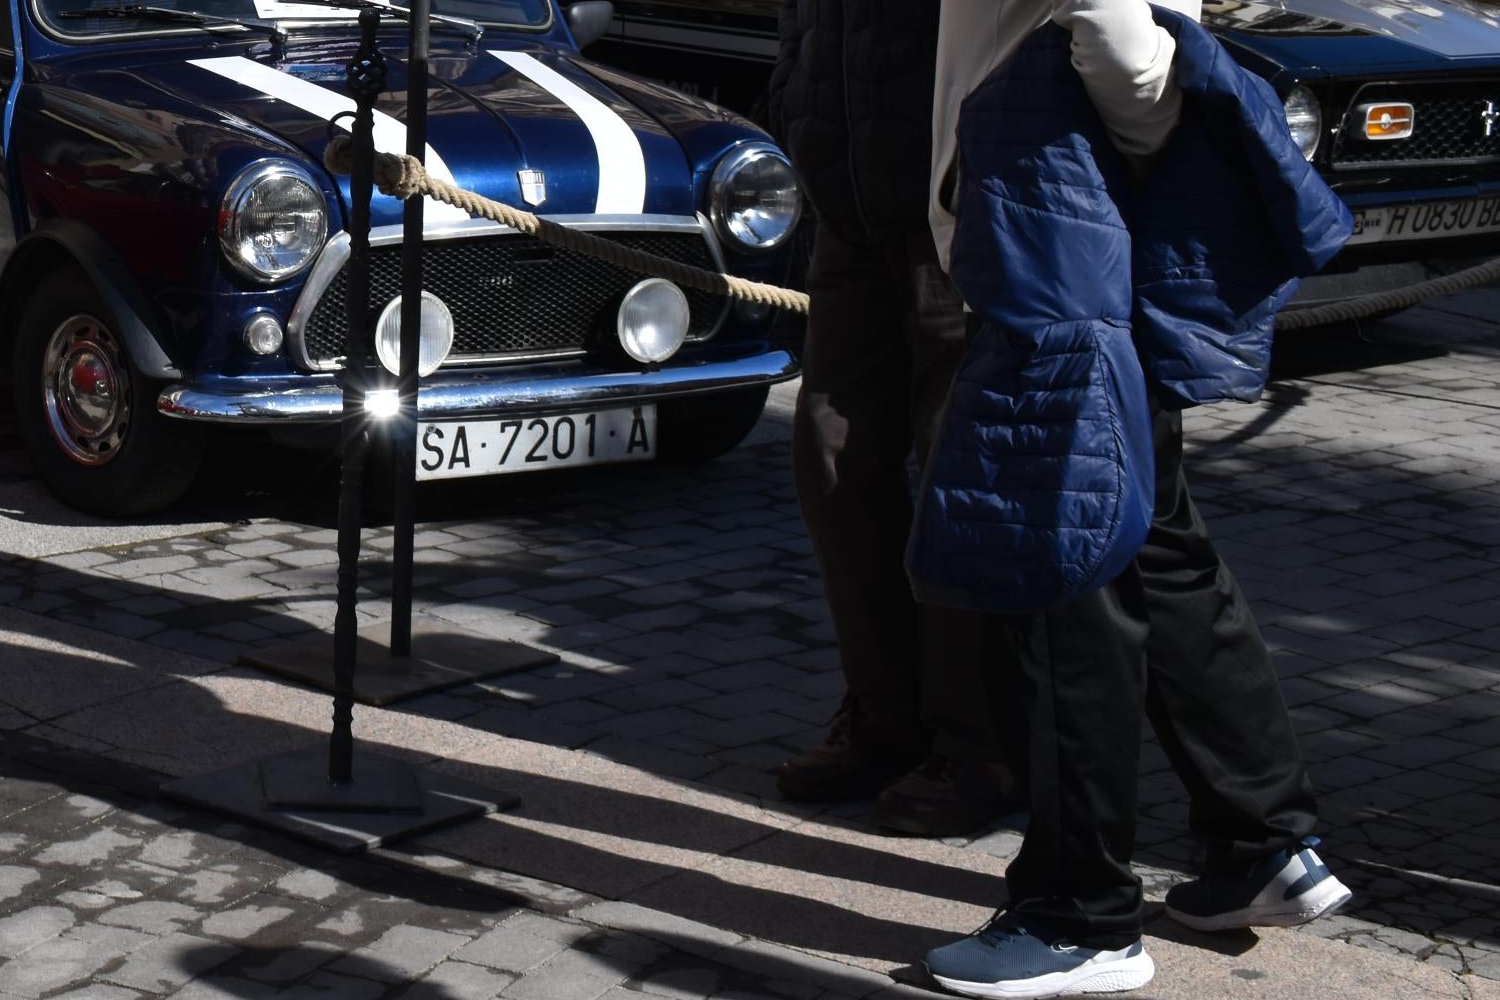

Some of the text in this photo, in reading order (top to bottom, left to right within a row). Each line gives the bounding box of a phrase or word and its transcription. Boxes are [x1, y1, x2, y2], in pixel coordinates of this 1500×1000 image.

[420, 425, 471, 472] SA
[498, 413, 597, 466] 7201
[626, 408, 650, 454] A
